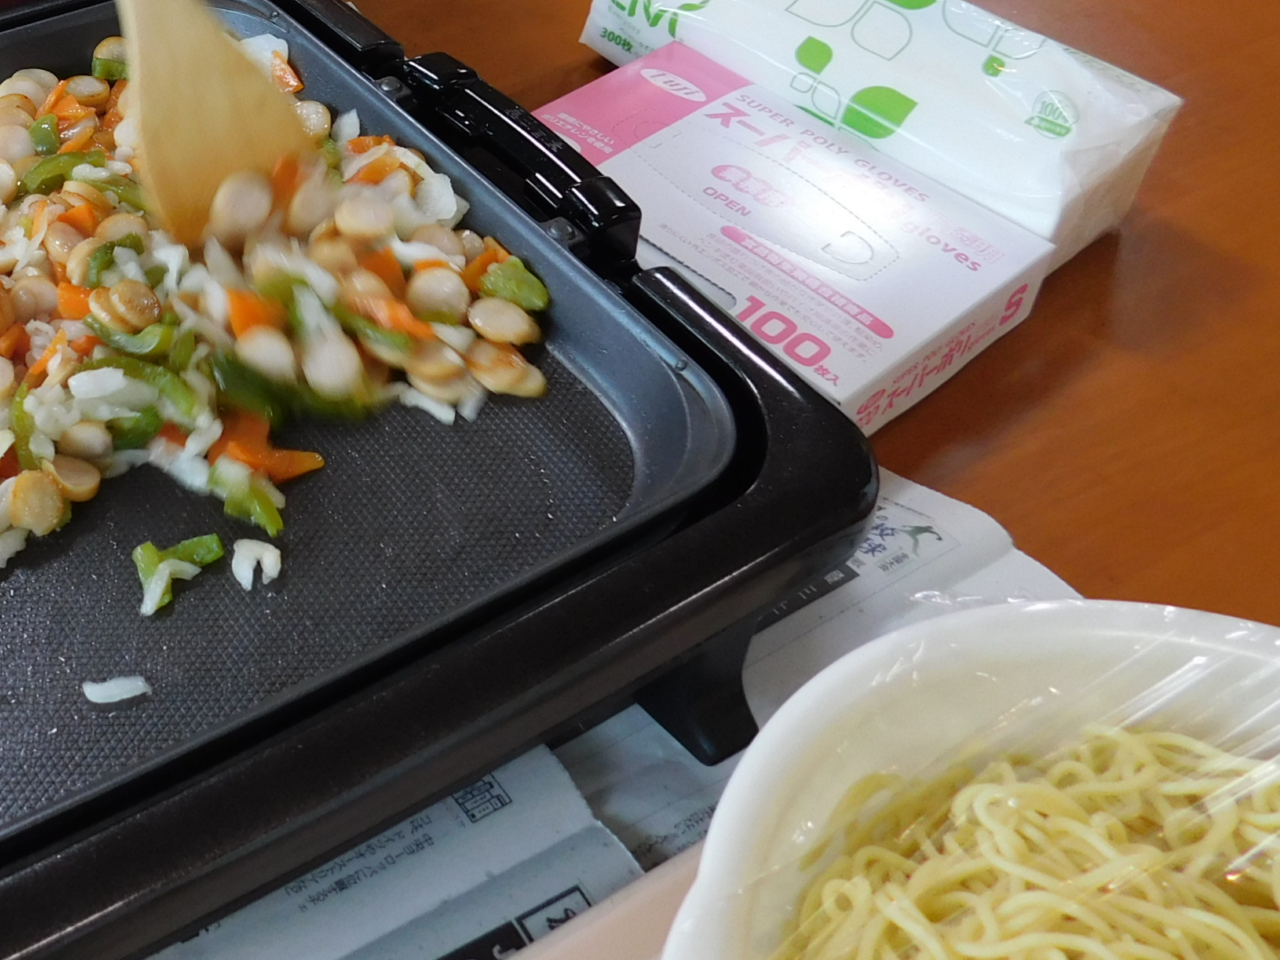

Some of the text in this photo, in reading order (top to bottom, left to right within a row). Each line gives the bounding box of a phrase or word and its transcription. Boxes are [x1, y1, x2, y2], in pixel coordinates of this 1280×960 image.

[599, 26, 634, 56] 300枚
[734, 92, 931, 204] SUPER POLY GLOVES
[702, 185, 753, 219] OPEN
[900, 220, 983, 274] gloves
[998, 282, 1030, 327] S
[735, 294, 841, 388] 100枚入
